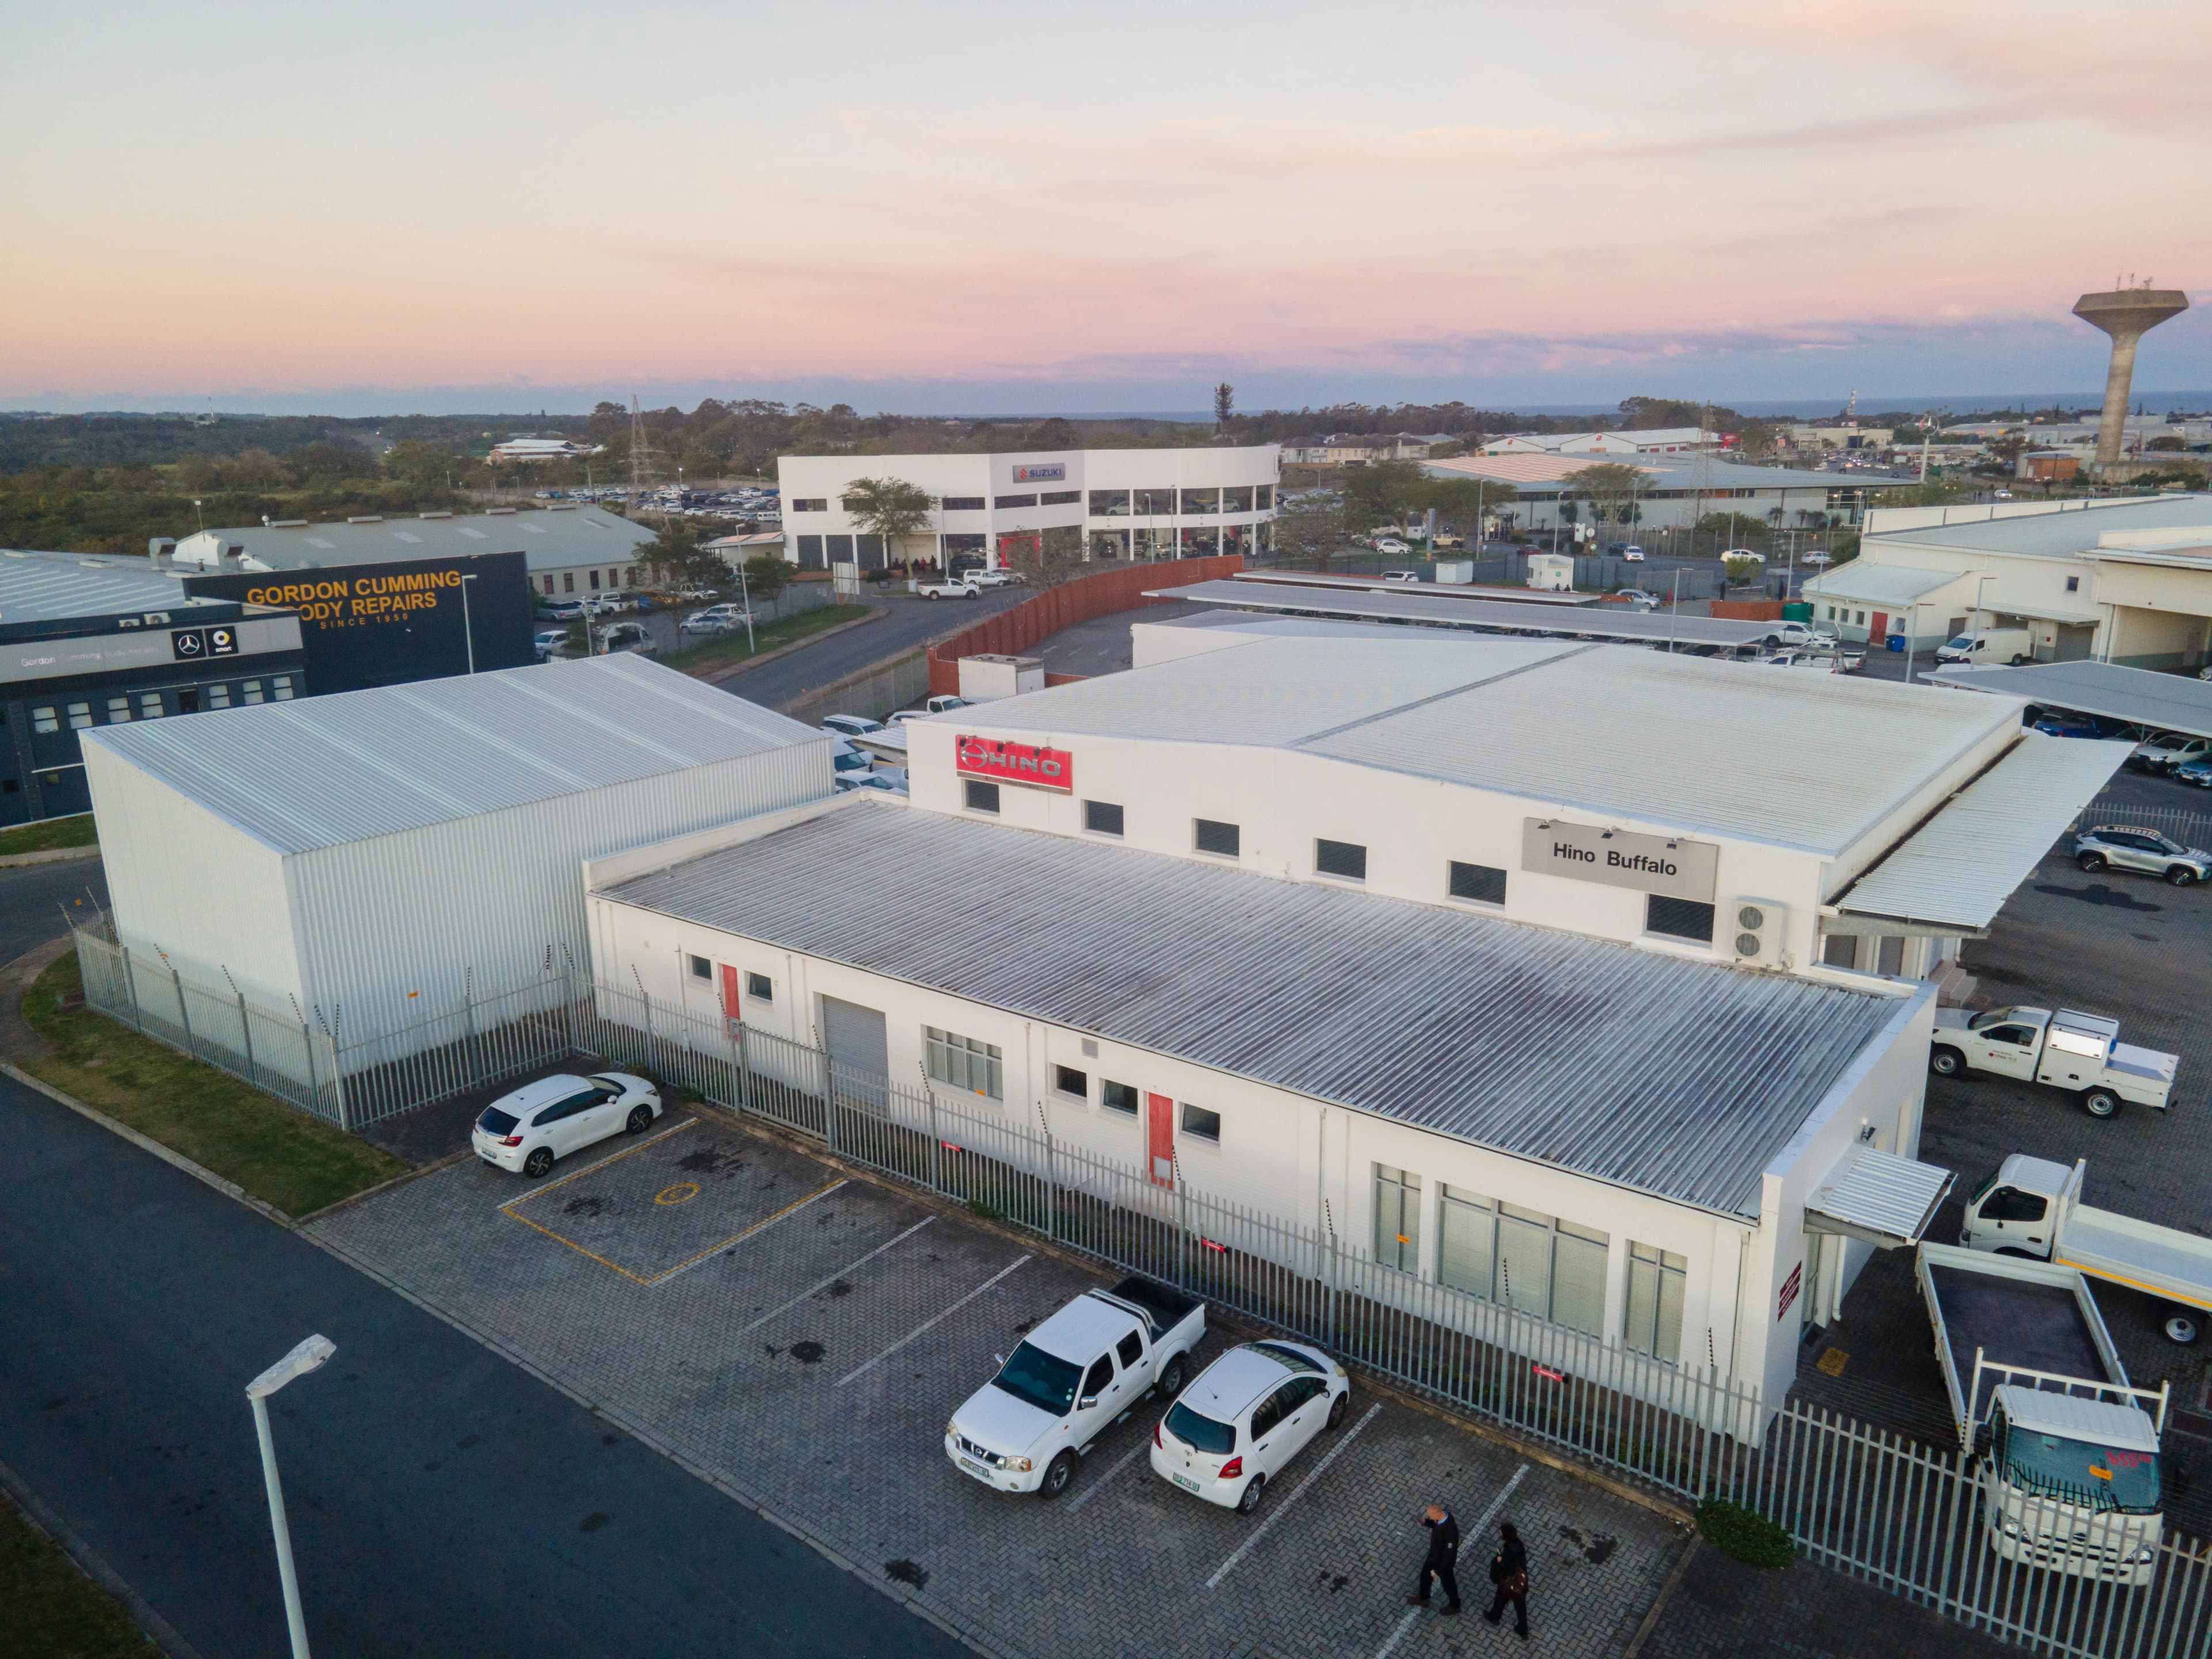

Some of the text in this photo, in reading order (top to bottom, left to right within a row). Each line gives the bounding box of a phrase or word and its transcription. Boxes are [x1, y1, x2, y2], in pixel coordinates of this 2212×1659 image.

[1029, 468, 1061, 478] SUZUKI
[247, 570, 462, 605] GORDON CUMMING
[285, 592, 437, 621] ODY REPAIRS
[320, 613, 408, 630] SINCE 1950
[21, 656, 56, 667] Gordon
[989, 752, 1060, 777] HINO
[1554, 842, 1677, 876] Hino Buffalo
